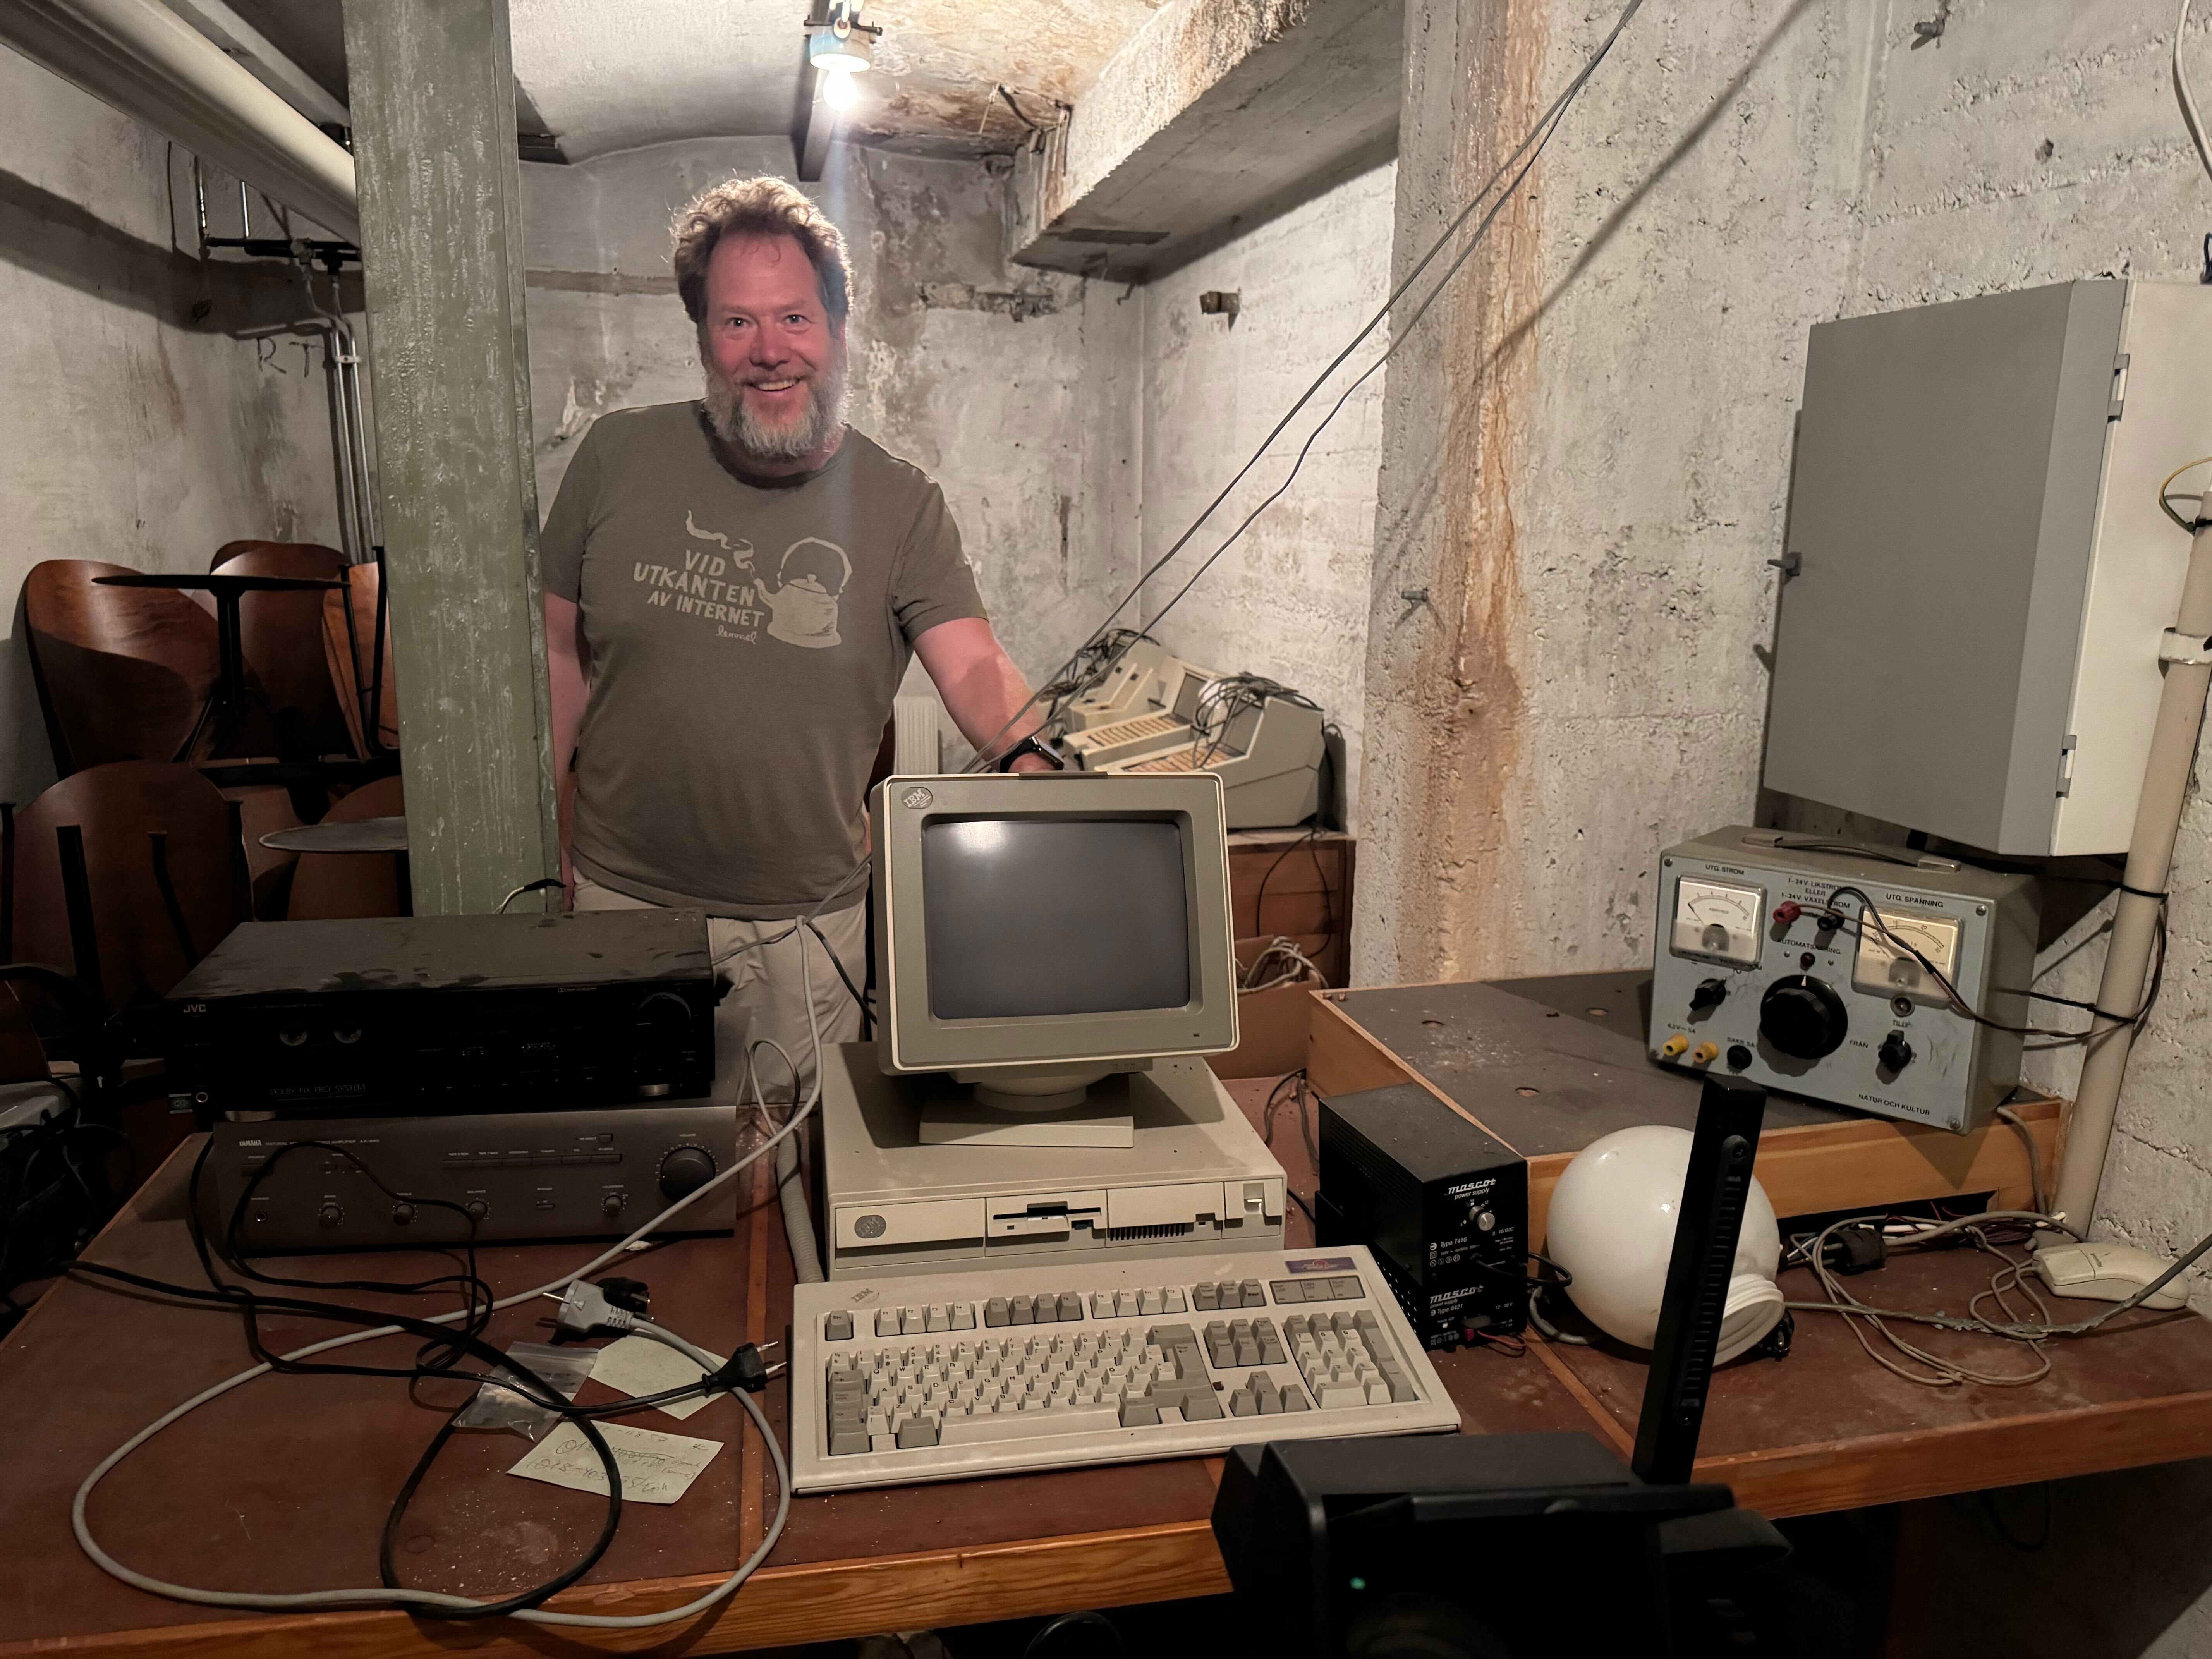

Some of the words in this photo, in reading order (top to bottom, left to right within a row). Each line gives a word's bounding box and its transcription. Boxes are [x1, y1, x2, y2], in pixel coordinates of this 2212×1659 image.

[685, 549, 726, 576] VID
[634, 562, 755, 607] UTKANTEN
[647, 590, 672, 606] AV
[676, 595, 765, 627] INTERNET
[904, 788, 925, 807] IBM
[183, 1004, 206, 1013] JVC
[1858, 1094, 1882, 1104] NATUR
[1884, 1099, 1900, 1108] OCH
[1901, 1104, 1930, 1115] KULTUR
[1448, 1178, 1496, 1195] mascot
[1455, 1192, 1472, 1200] power
[1472, 1187, 1490, 1196] supply
[851, 1288, 874, 1302] IBM
[1430, 1284, 1484, 1304] mascot
